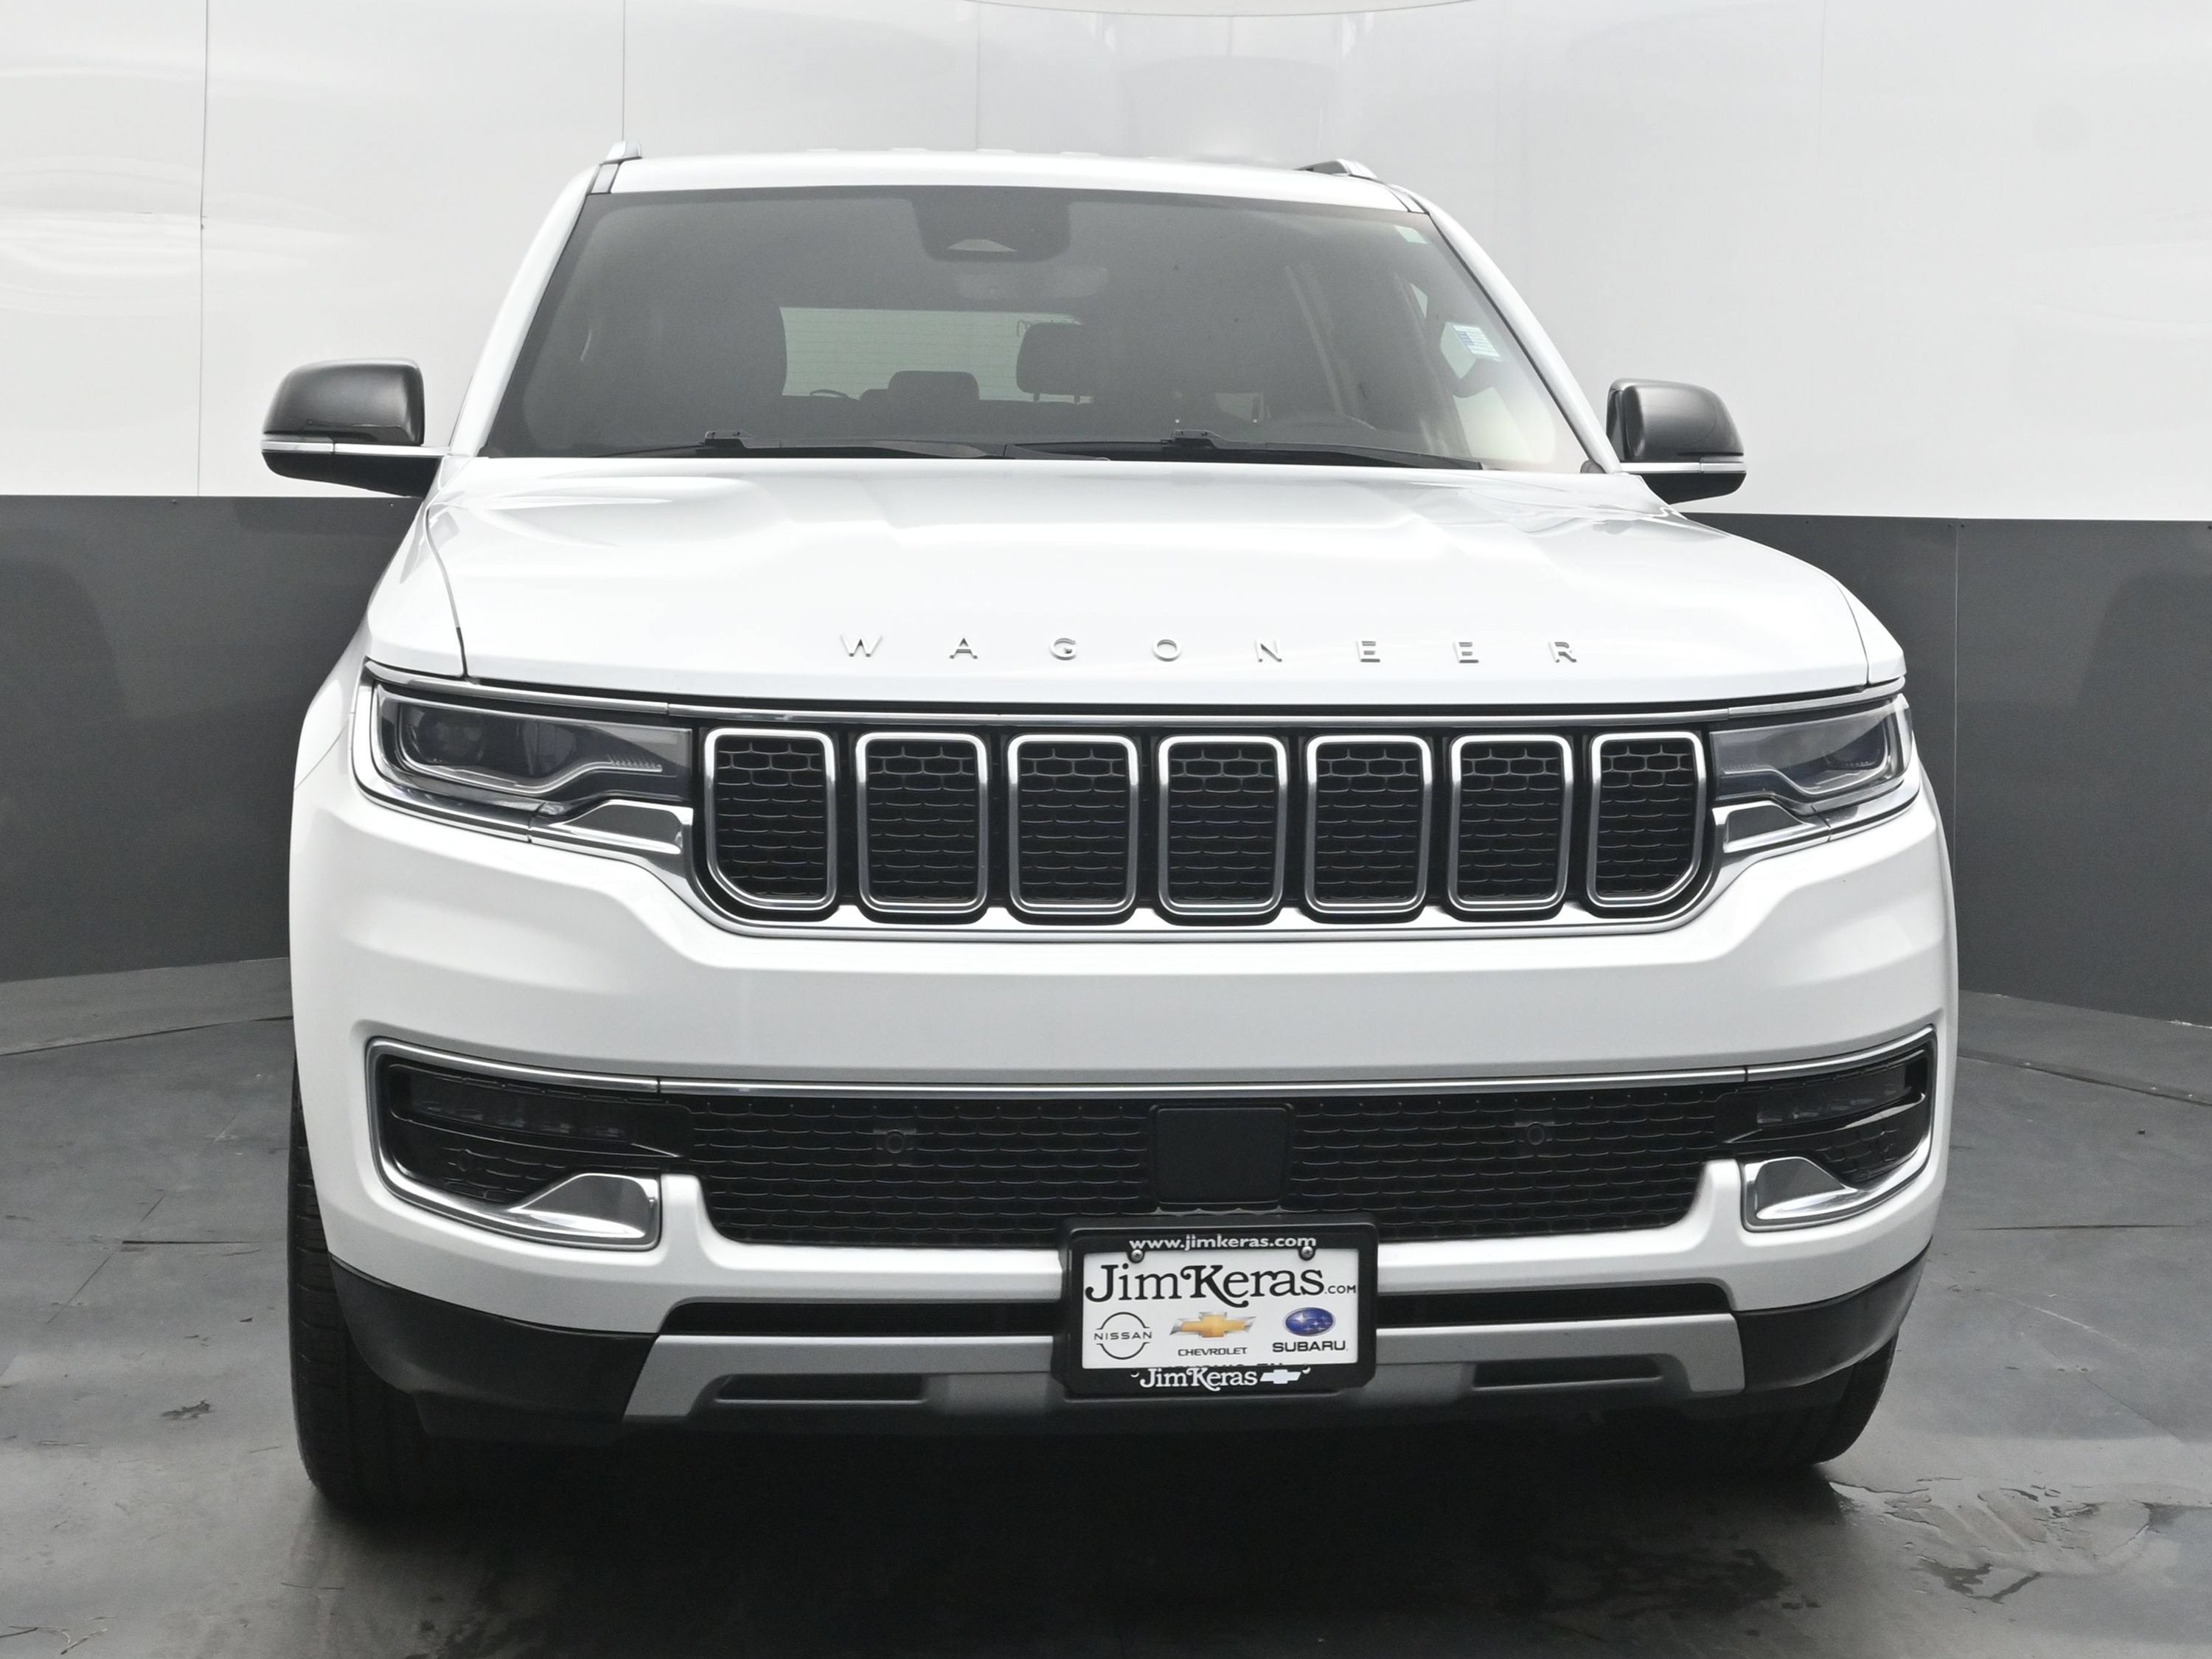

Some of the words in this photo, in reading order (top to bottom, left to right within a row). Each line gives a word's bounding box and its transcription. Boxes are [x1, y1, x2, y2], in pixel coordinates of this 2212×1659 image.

[839, 633, 1577, 663] WAGONEER
[1129, 1234, 1317, 1251] www.jimkeras.com
[1093, 1331, 1152, 1340] NISSAN
[1178, 1347, 1248, 1357] CHEVROLET
[1272, 1340, 1346, 1353] SUBARU
